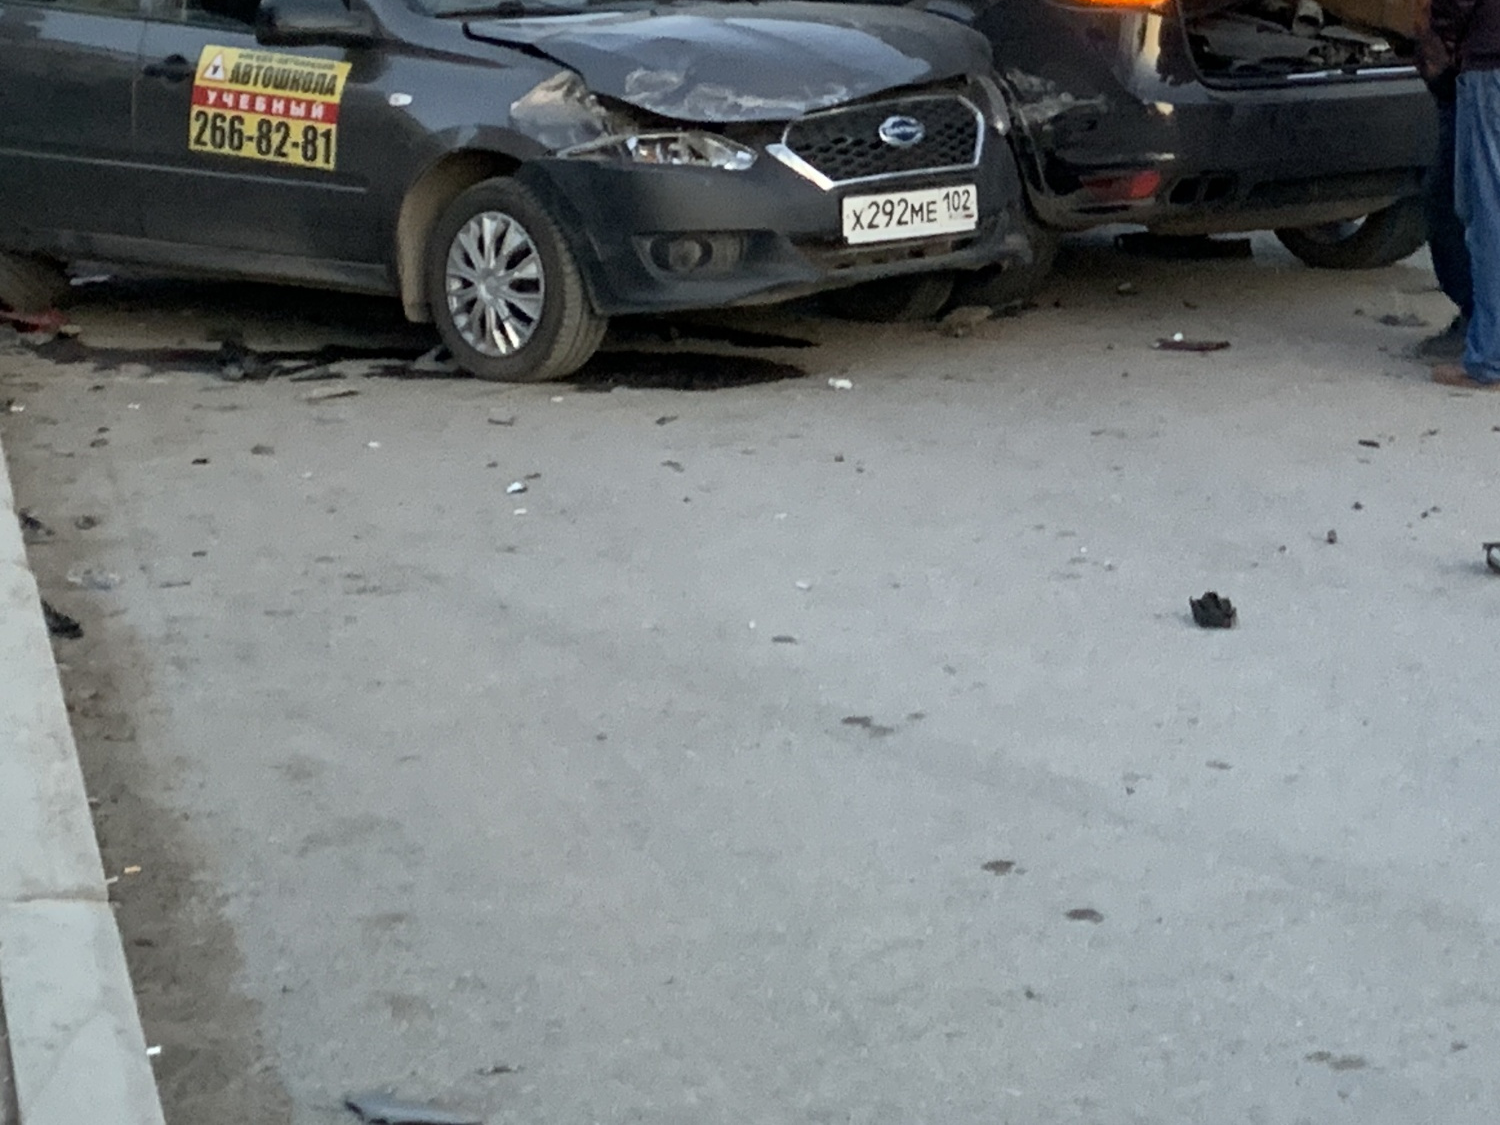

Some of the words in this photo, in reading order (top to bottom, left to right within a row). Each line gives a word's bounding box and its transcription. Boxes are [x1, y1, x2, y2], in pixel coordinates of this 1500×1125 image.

[228, 61, 338, 96] АВТОШКОЛА
[206, 89, 324, 119] УЧЕБНЫЙ
[193, 110, 333, 165] 266-82-81
[942, 188, 971, 213] 102
